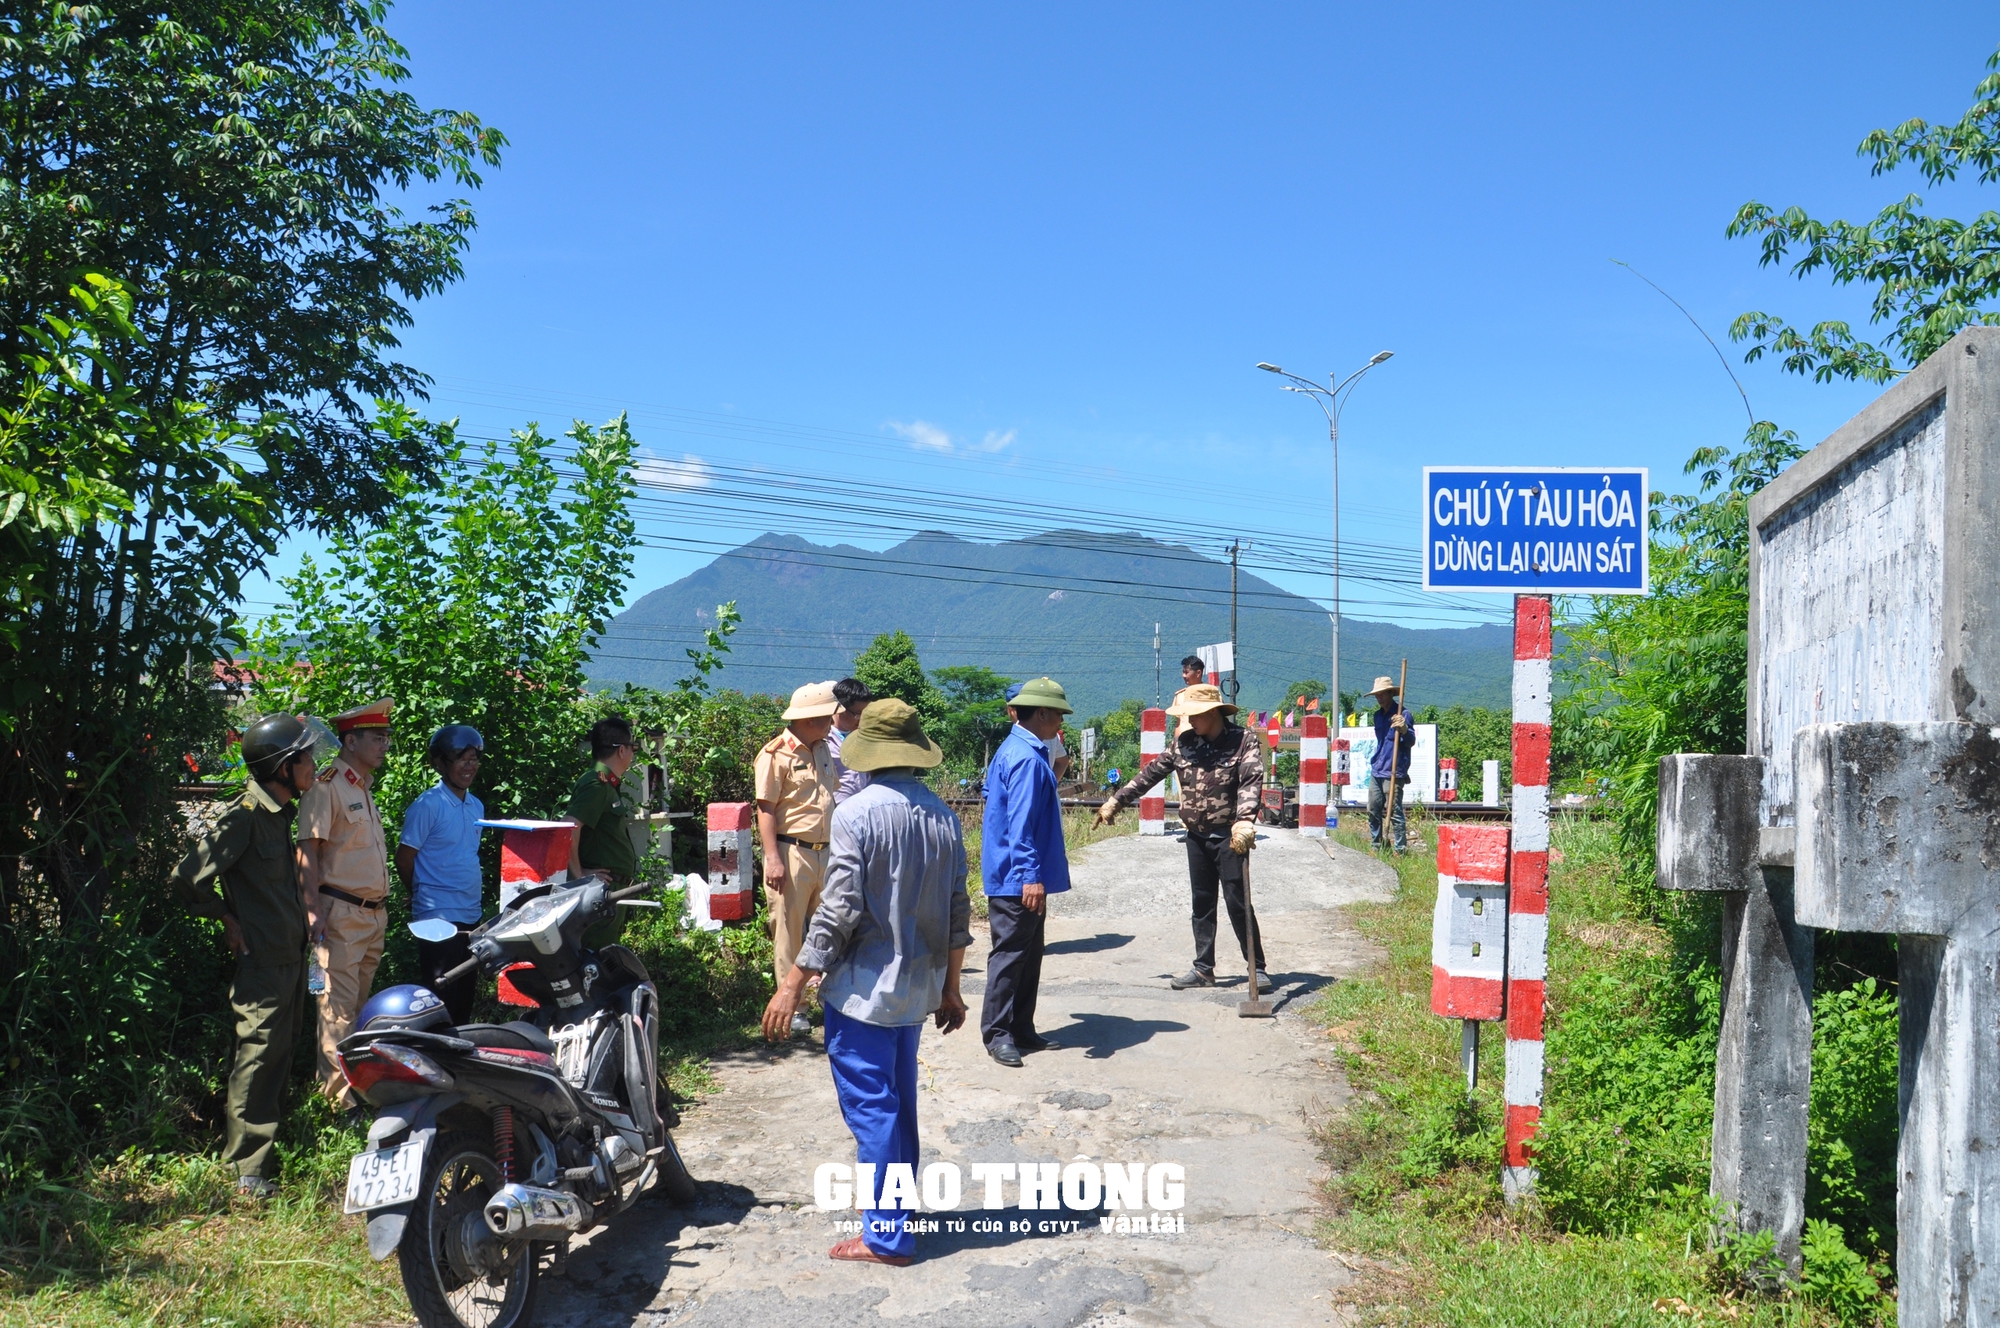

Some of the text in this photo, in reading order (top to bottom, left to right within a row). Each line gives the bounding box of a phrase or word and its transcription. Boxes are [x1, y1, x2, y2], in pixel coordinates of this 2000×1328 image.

[1434, 475, 1636, 528] CHÚ Ý TÀU HỎA
[1434, 534, 1635, 574] DỪNG LẠI QUAN SÁT
[591, 1095, 620, 1108] HONDA
[352, 1173, 413, 1208] 172.34
